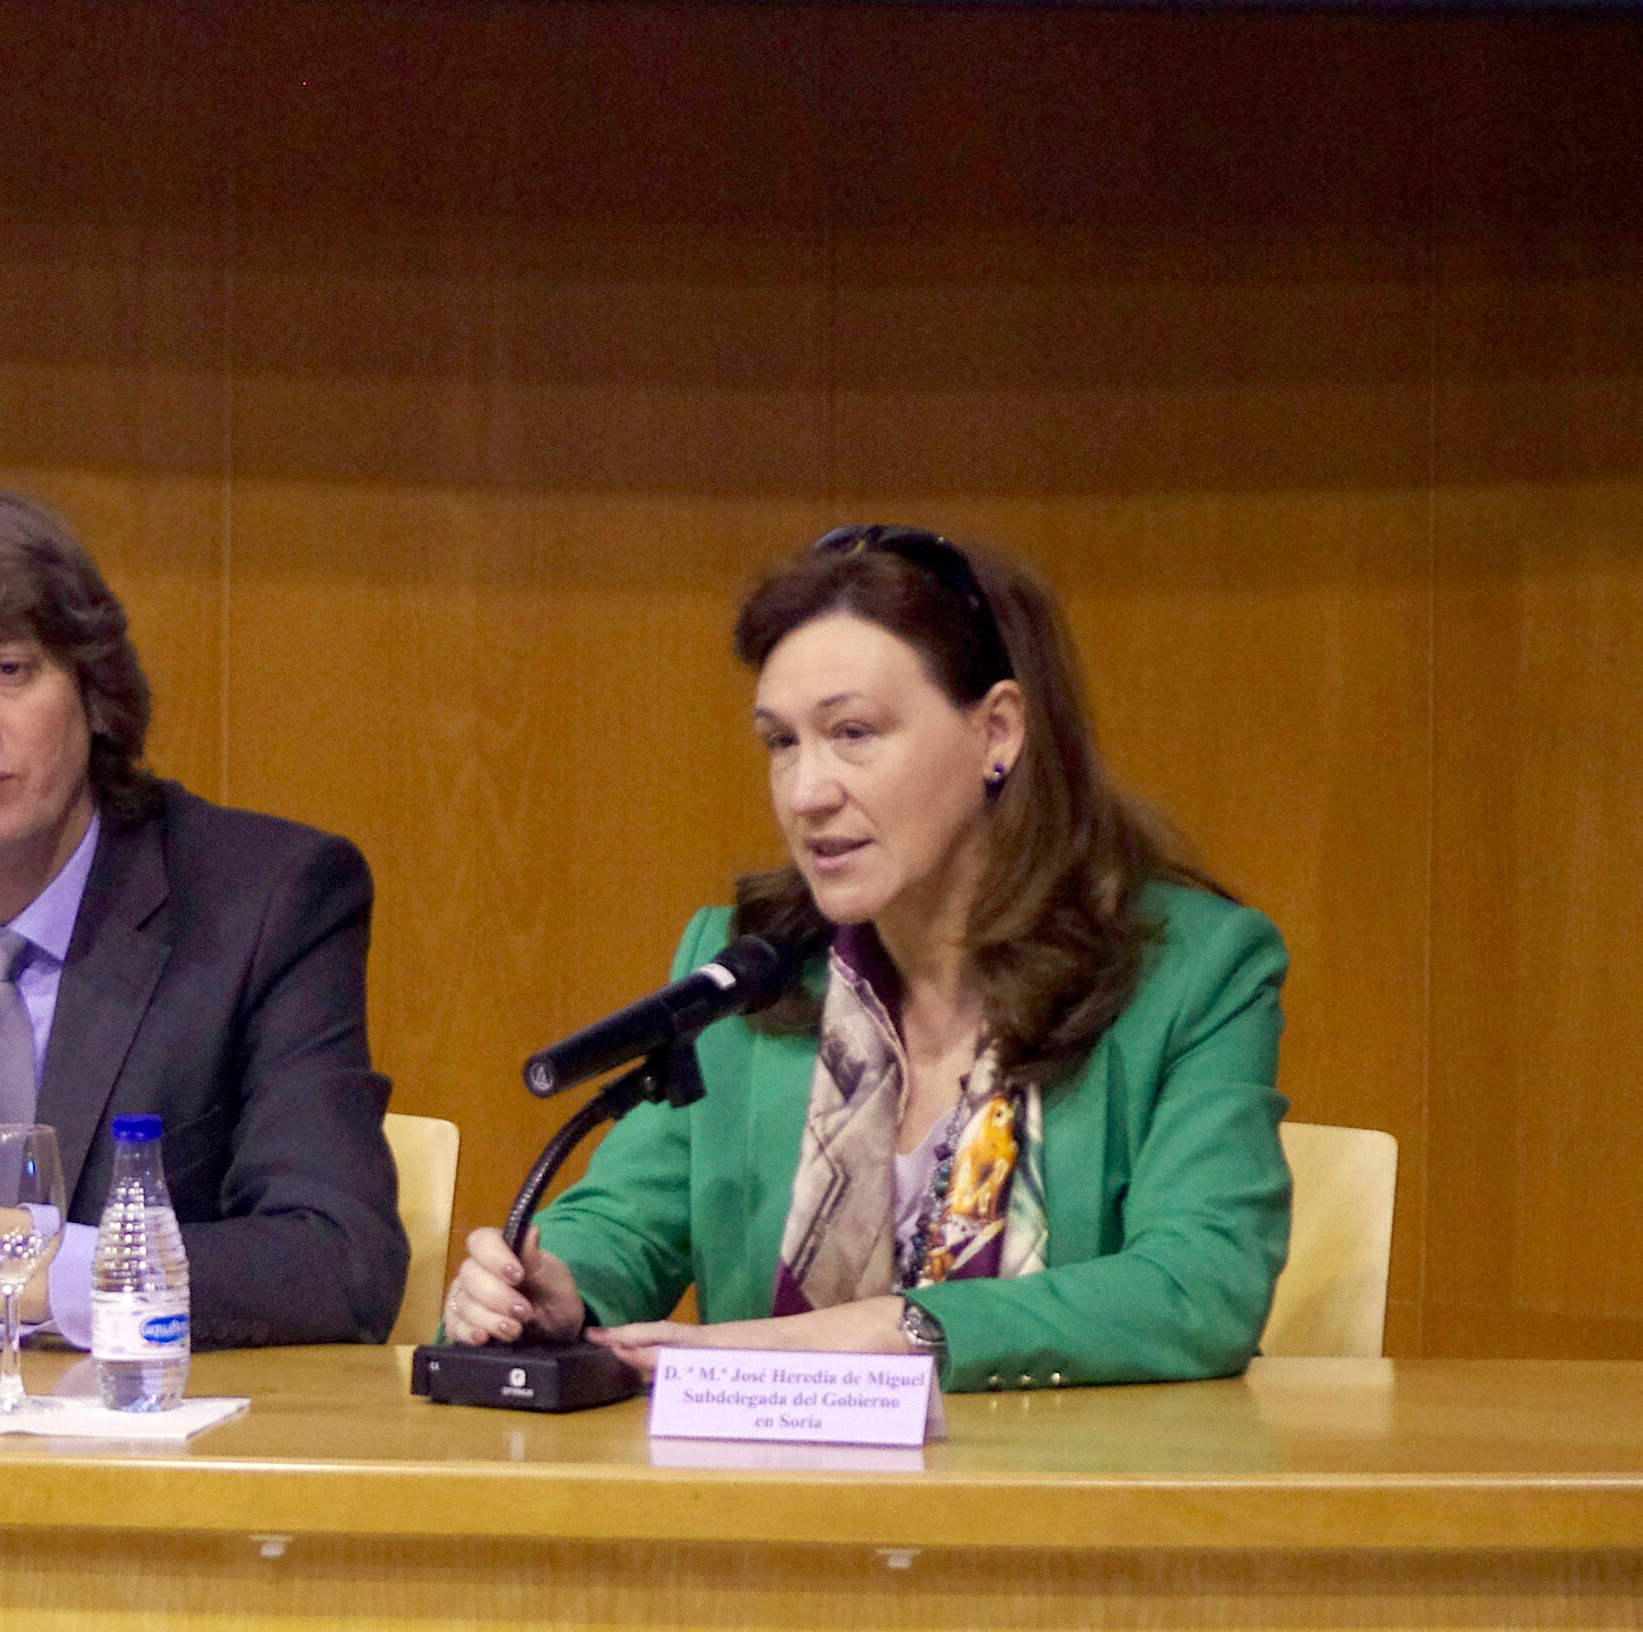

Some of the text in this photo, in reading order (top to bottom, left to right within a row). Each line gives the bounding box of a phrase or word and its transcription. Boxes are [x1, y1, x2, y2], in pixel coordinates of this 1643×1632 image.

[732, 1368, 766, 1384] José
[772, 1368, 837, 1384] Heredia
[843, 1369, 862, 1385] de
[868, 1371, 925, 1389] Miguel
[683, 1389, 900, 1408] Subdelegada del Gobierno
[755, 1413, 823, 1429] en Soria
